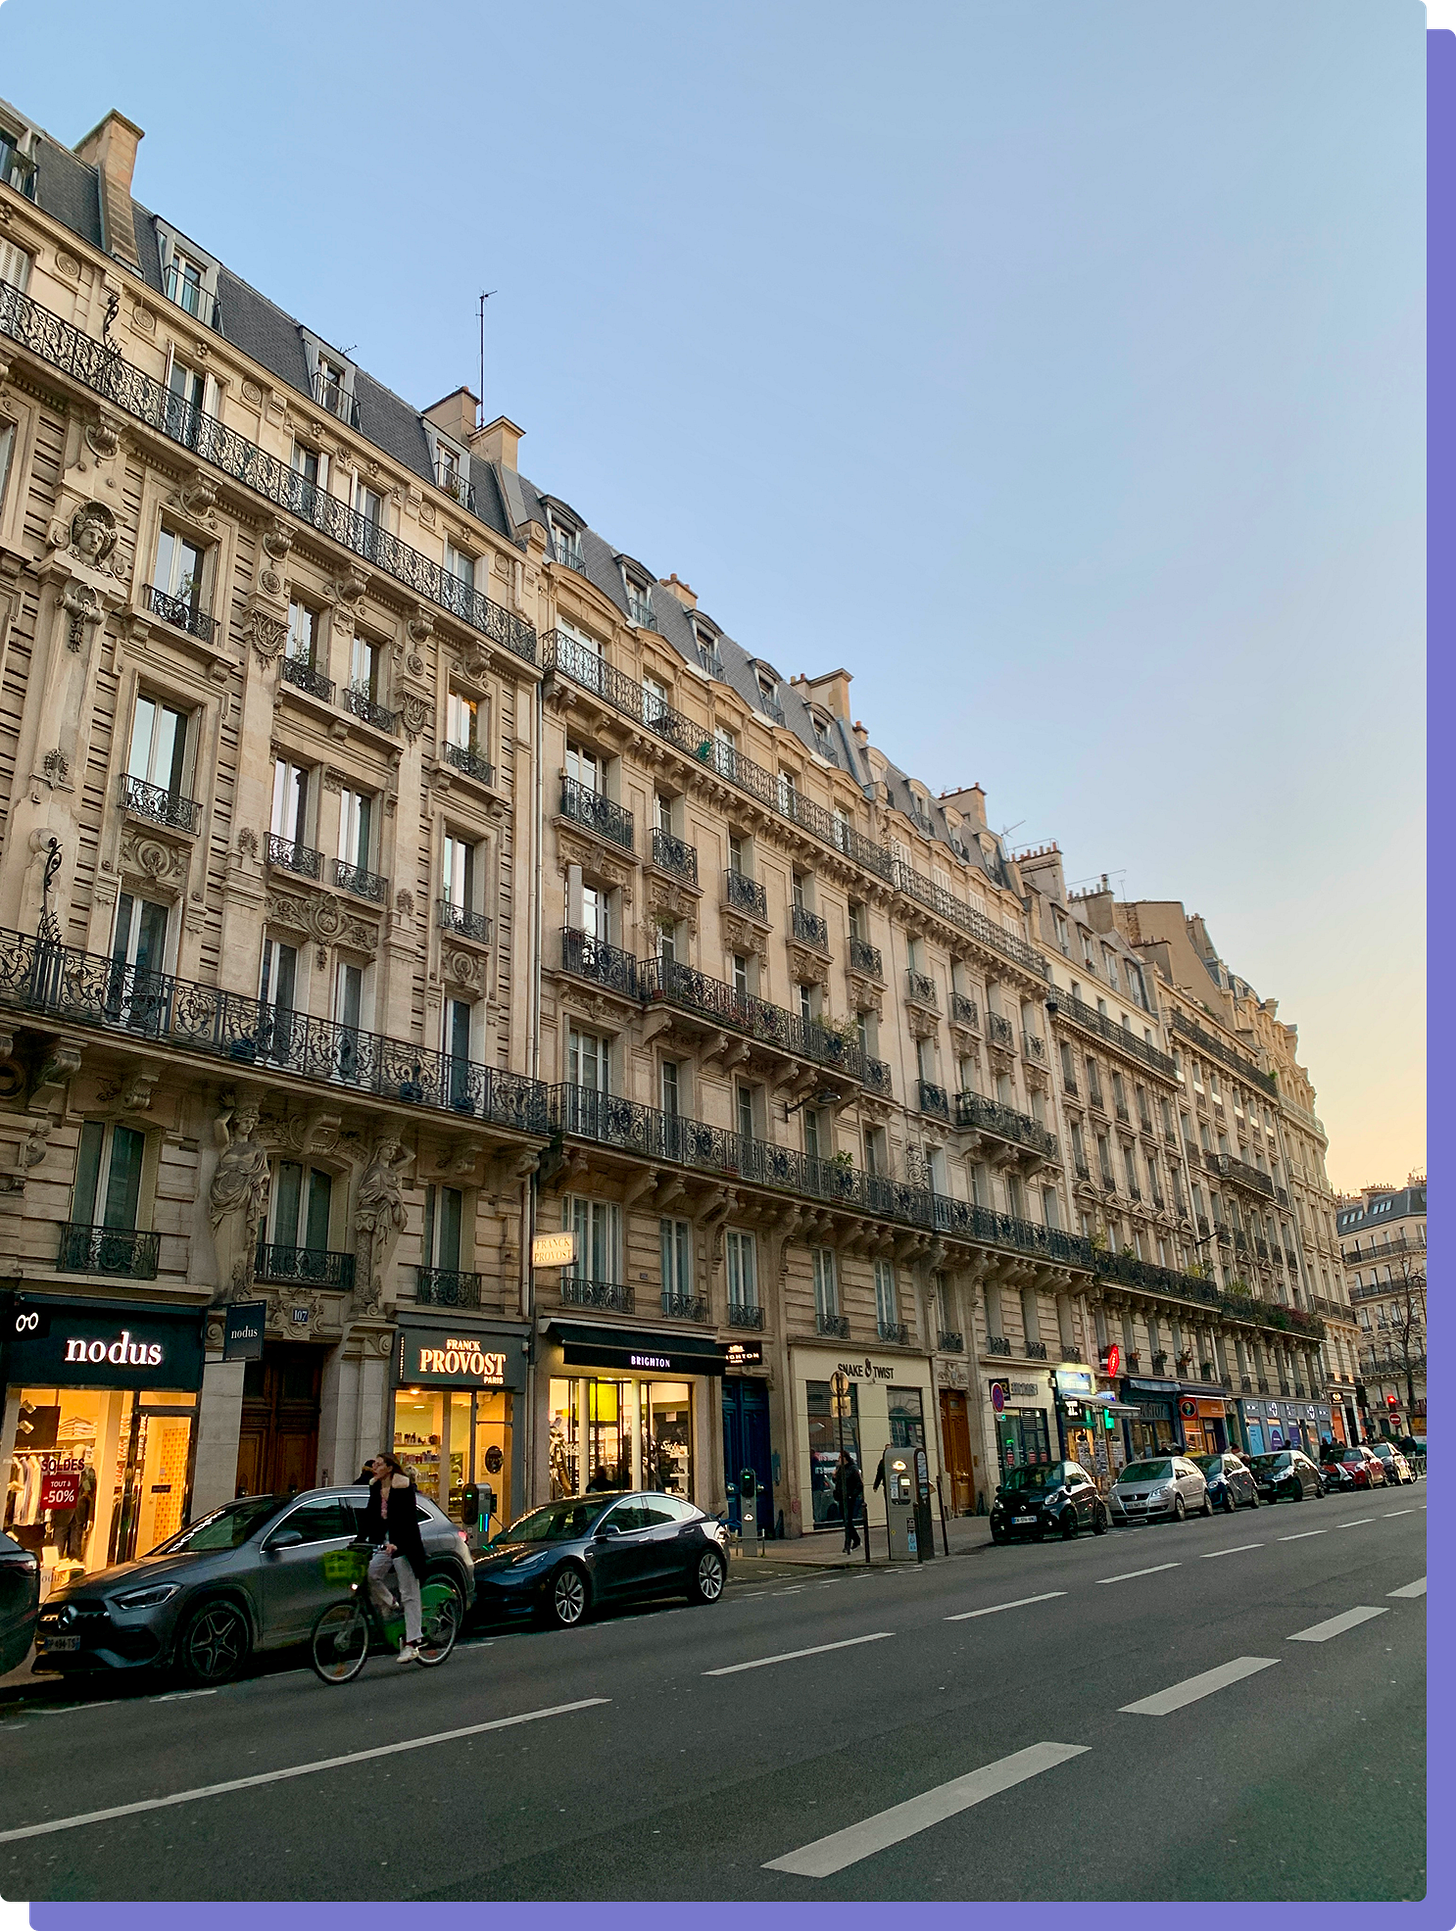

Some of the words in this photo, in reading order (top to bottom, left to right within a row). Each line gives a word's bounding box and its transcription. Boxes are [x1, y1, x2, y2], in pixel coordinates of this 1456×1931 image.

[536, 1237, 570, 1250] FRANCK
[534, 1249, 571, 1262] PROVOST
[294, 1309, 308, 1322] 107
[230, 1325, 259, 1339] nodus
[64, 1331, 163, 1366] nodus
[446, 1338, 481, 1351] FRANCK
[419, 1348, 507, 1376] PROVOST
[630, 1355, 671, 1368] BRIGHTON
[838, 1363, 863, 1377] SNAKE
[873, 1366, 894, 1379] TWIST
[483, 1376, 504, 1385] PARIS
[41, 1457, 86, 1472] SOLDES
[50, 1480, 67, 1488] TOUT
[43, 1489, 75, 1504] -50%
